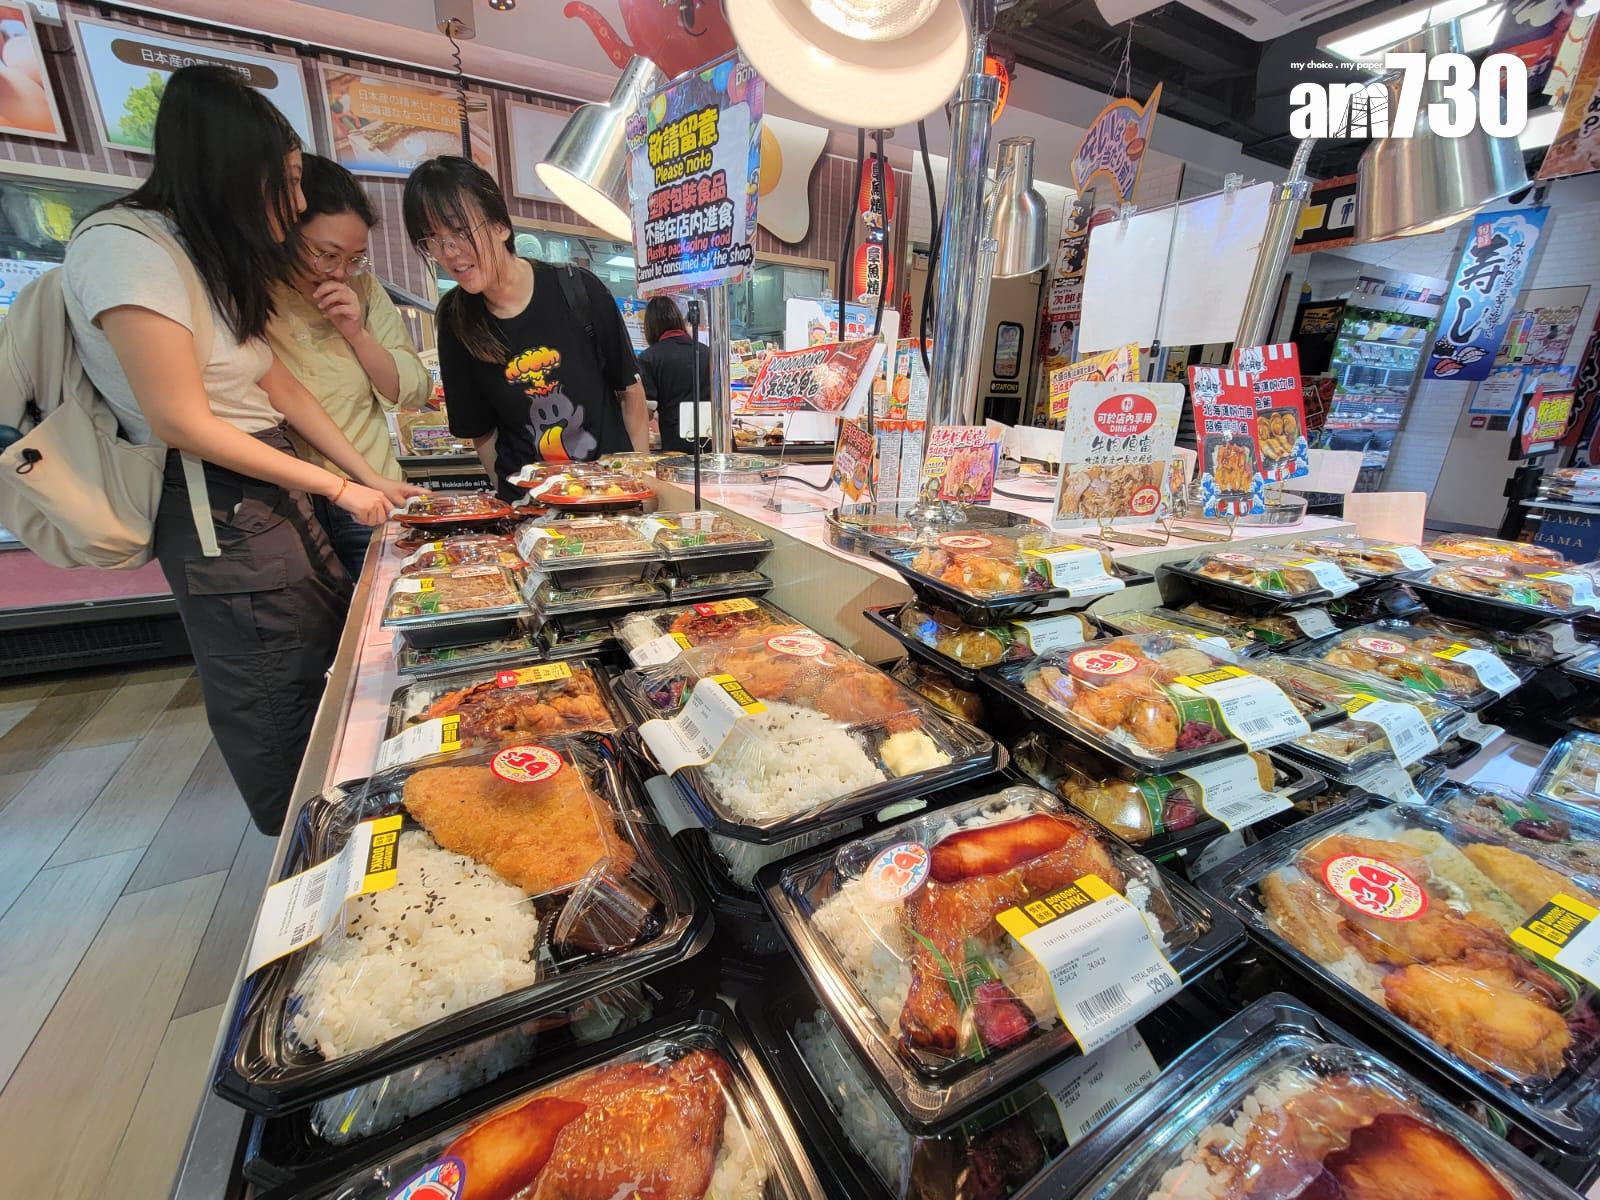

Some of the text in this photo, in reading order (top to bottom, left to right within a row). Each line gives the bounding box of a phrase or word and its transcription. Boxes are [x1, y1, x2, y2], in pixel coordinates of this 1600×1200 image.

[648, 108, 719, 166] 敬請留意
[655, 150, 712, 186] Please note
[648, 172, 726, 220] 塑膠包裝食品
[668, 236, 708, 258] packaging
[710, 229, 731, 248] food
[663, 256, 699, 274] consumed
[713, 250, 727, 266] the
[1110, 425, 1138, 433] DINE-IN
[1052, 893, 1090, 914] DONKI
[1131, 963, 1163, 984] TOTAL PRICE
[1146, 972, 1174, 995] $29.00
